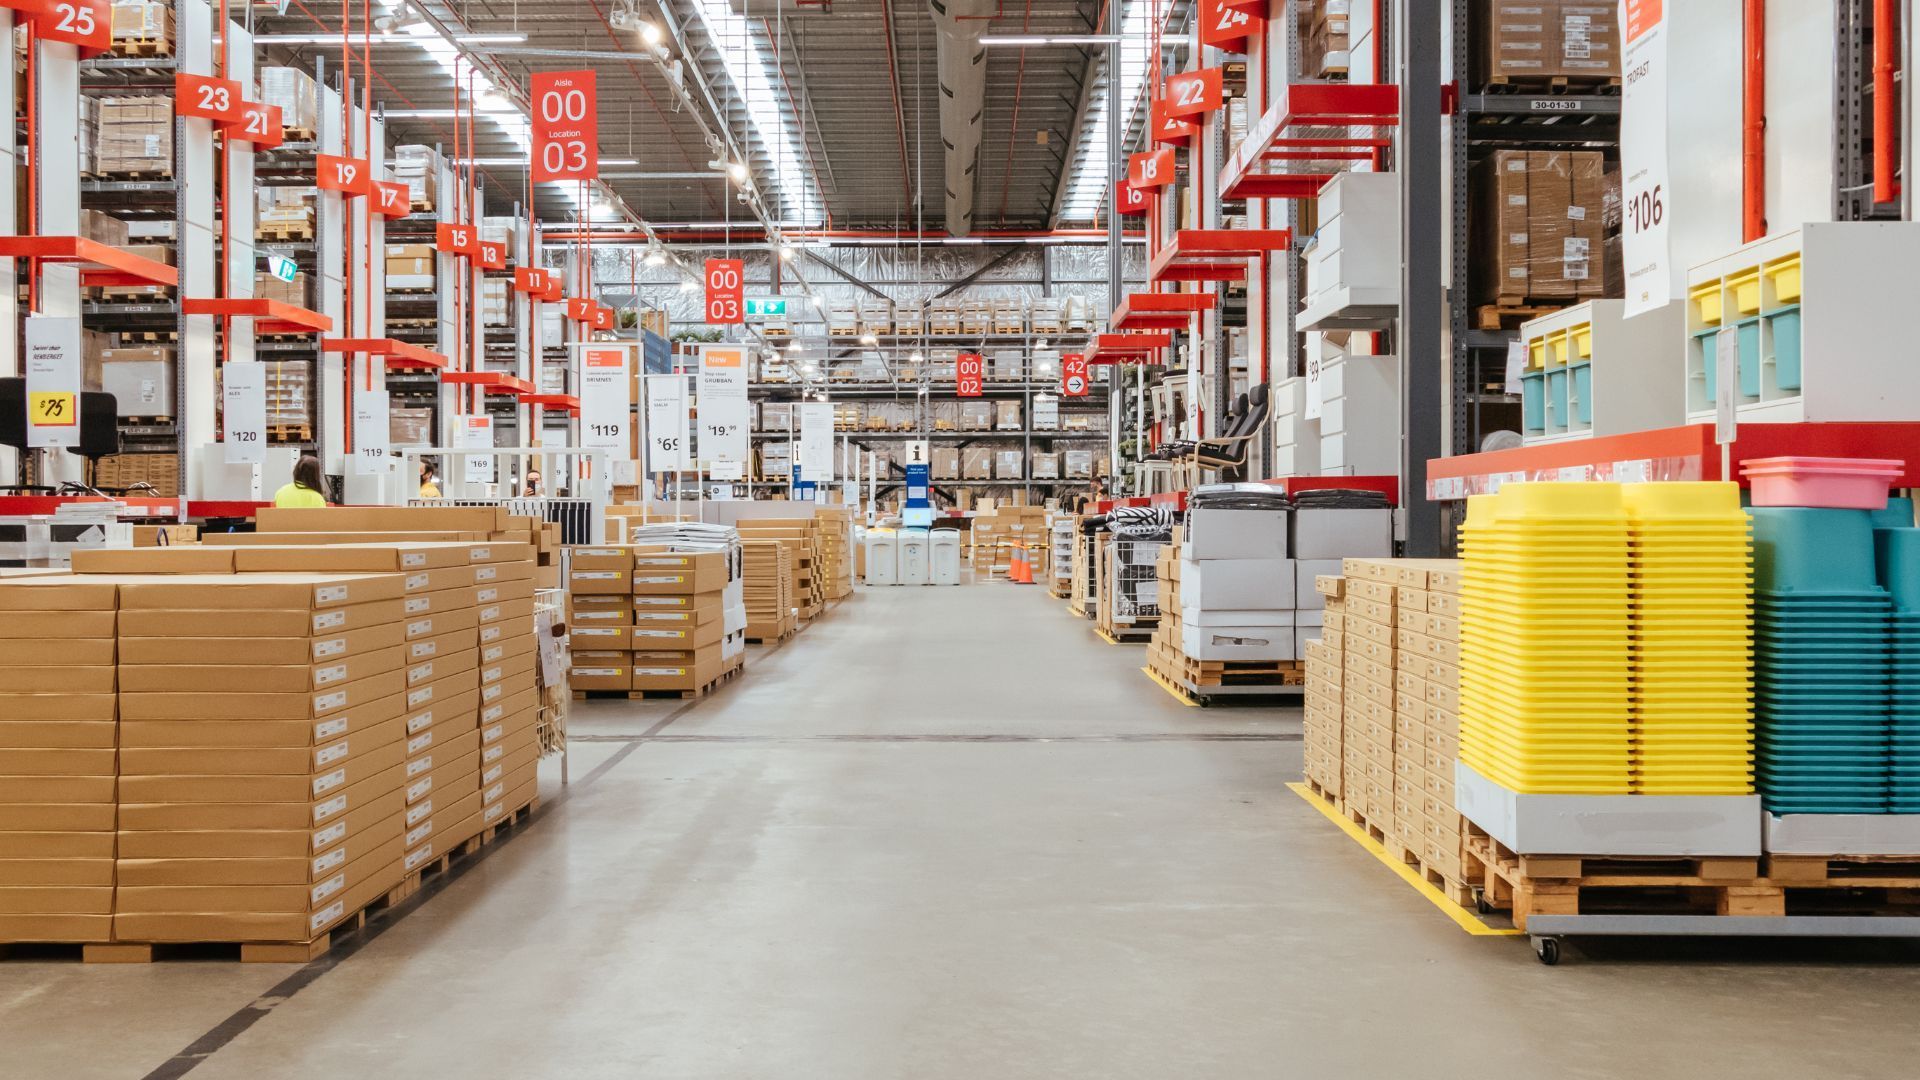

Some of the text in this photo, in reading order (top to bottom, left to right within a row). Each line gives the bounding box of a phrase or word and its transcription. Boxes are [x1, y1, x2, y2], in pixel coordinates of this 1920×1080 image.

[55, 3, 95, 35] 25
[554, 78, 573, 87] Aisle
[1626, 60, 1650, 88] TROFAST
[197, 85, 230, 112] 23
[1175, 79, 1205, 107] 22
[541, 89, 586, 122] 00
[1535, 101, 1576, 109] 30-01-30
[244, 110, 268, 136] 21
[548, 129, 581, 139] Location
[543, 140, 588, 173] 03
[335, 162, 357, 185] 19
[1140, 159, 1157, 180] 18
[380, 187, 399, 208] 17
[1628, 184, 1663, 235] $106
[451, 229, 468, 247] 15
[482, 246, 497, 263] 13
[528, 272, 541, 288] 11
[710, 270, 738, 290] 00
[580, 302, 589, 316] 7
[710, 300, 738, 319] 03
[597, 311, 605, 325] 5
[708, 355, 727, 364] New
[960, 361, 979, 375] 00
[1066, 361, 1084, 374] 42
[960, 381, 979, 394] 02
[39, 398, 66, 417] $75
[232, 430, 257, 442] $120
[591, 424, 619, 437] $119
[362, 447, 383, 457] $119
[470, 459, 488, 468] $169
